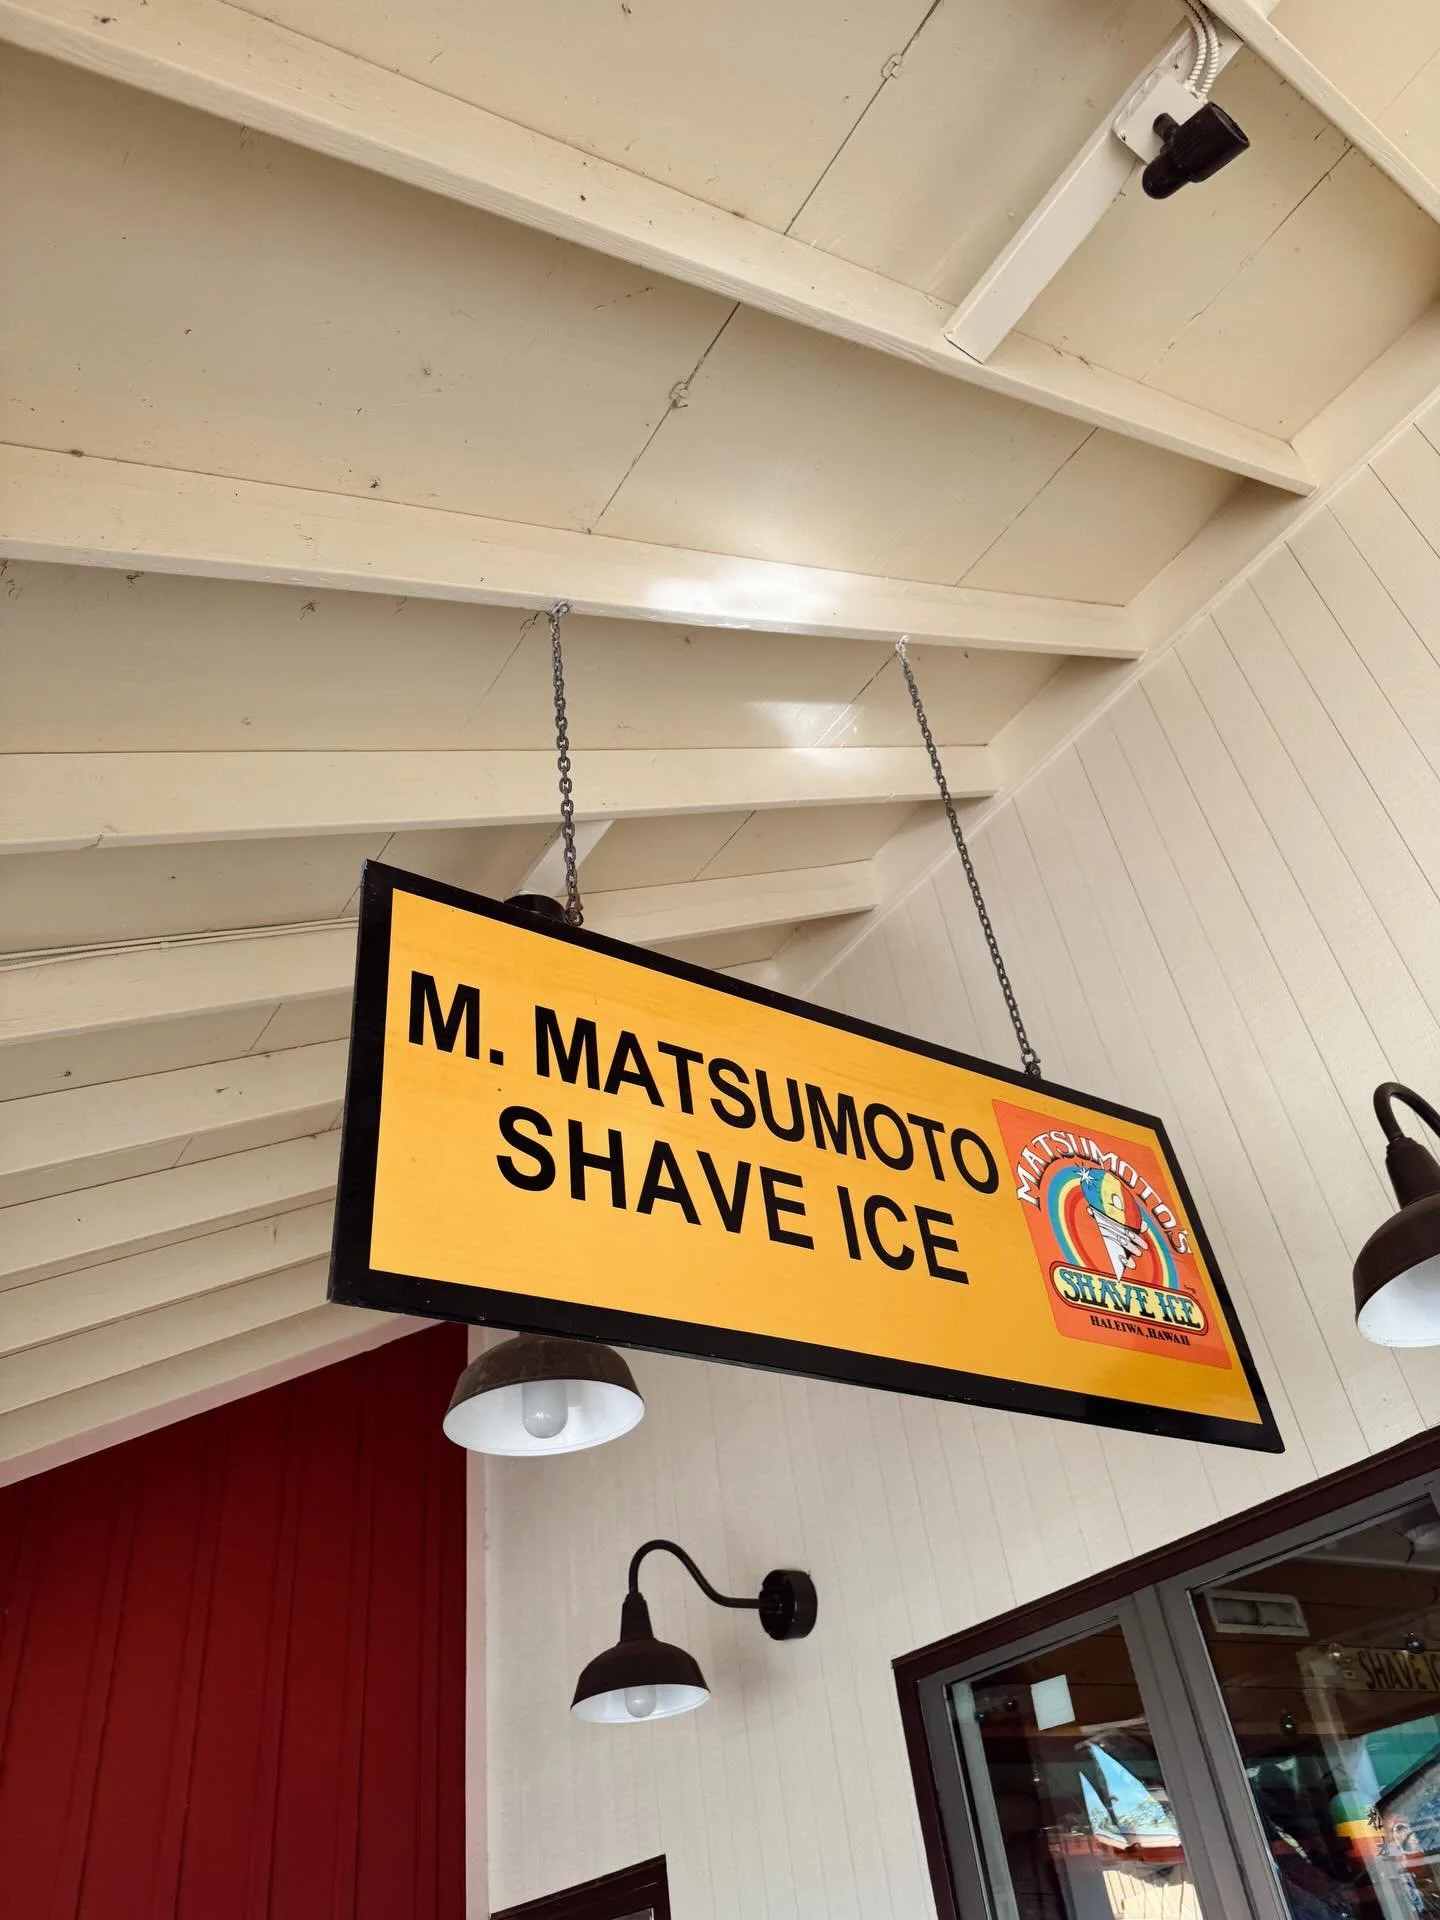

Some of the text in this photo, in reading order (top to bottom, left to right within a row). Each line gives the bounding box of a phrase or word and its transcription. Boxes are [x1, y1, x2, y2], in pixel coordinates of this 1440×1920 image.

[408, 970, 999, 1195] M. MATSUMOTO
[496, 1105, 970, 1285] SHAVE ICE
[1016, 1129, 1193, 1255] MATSUMOTO'S
[1058, 1267, 1202, 1329] SHAVE ICE
[1357, 1650, 1428, 1690] SHAVE
